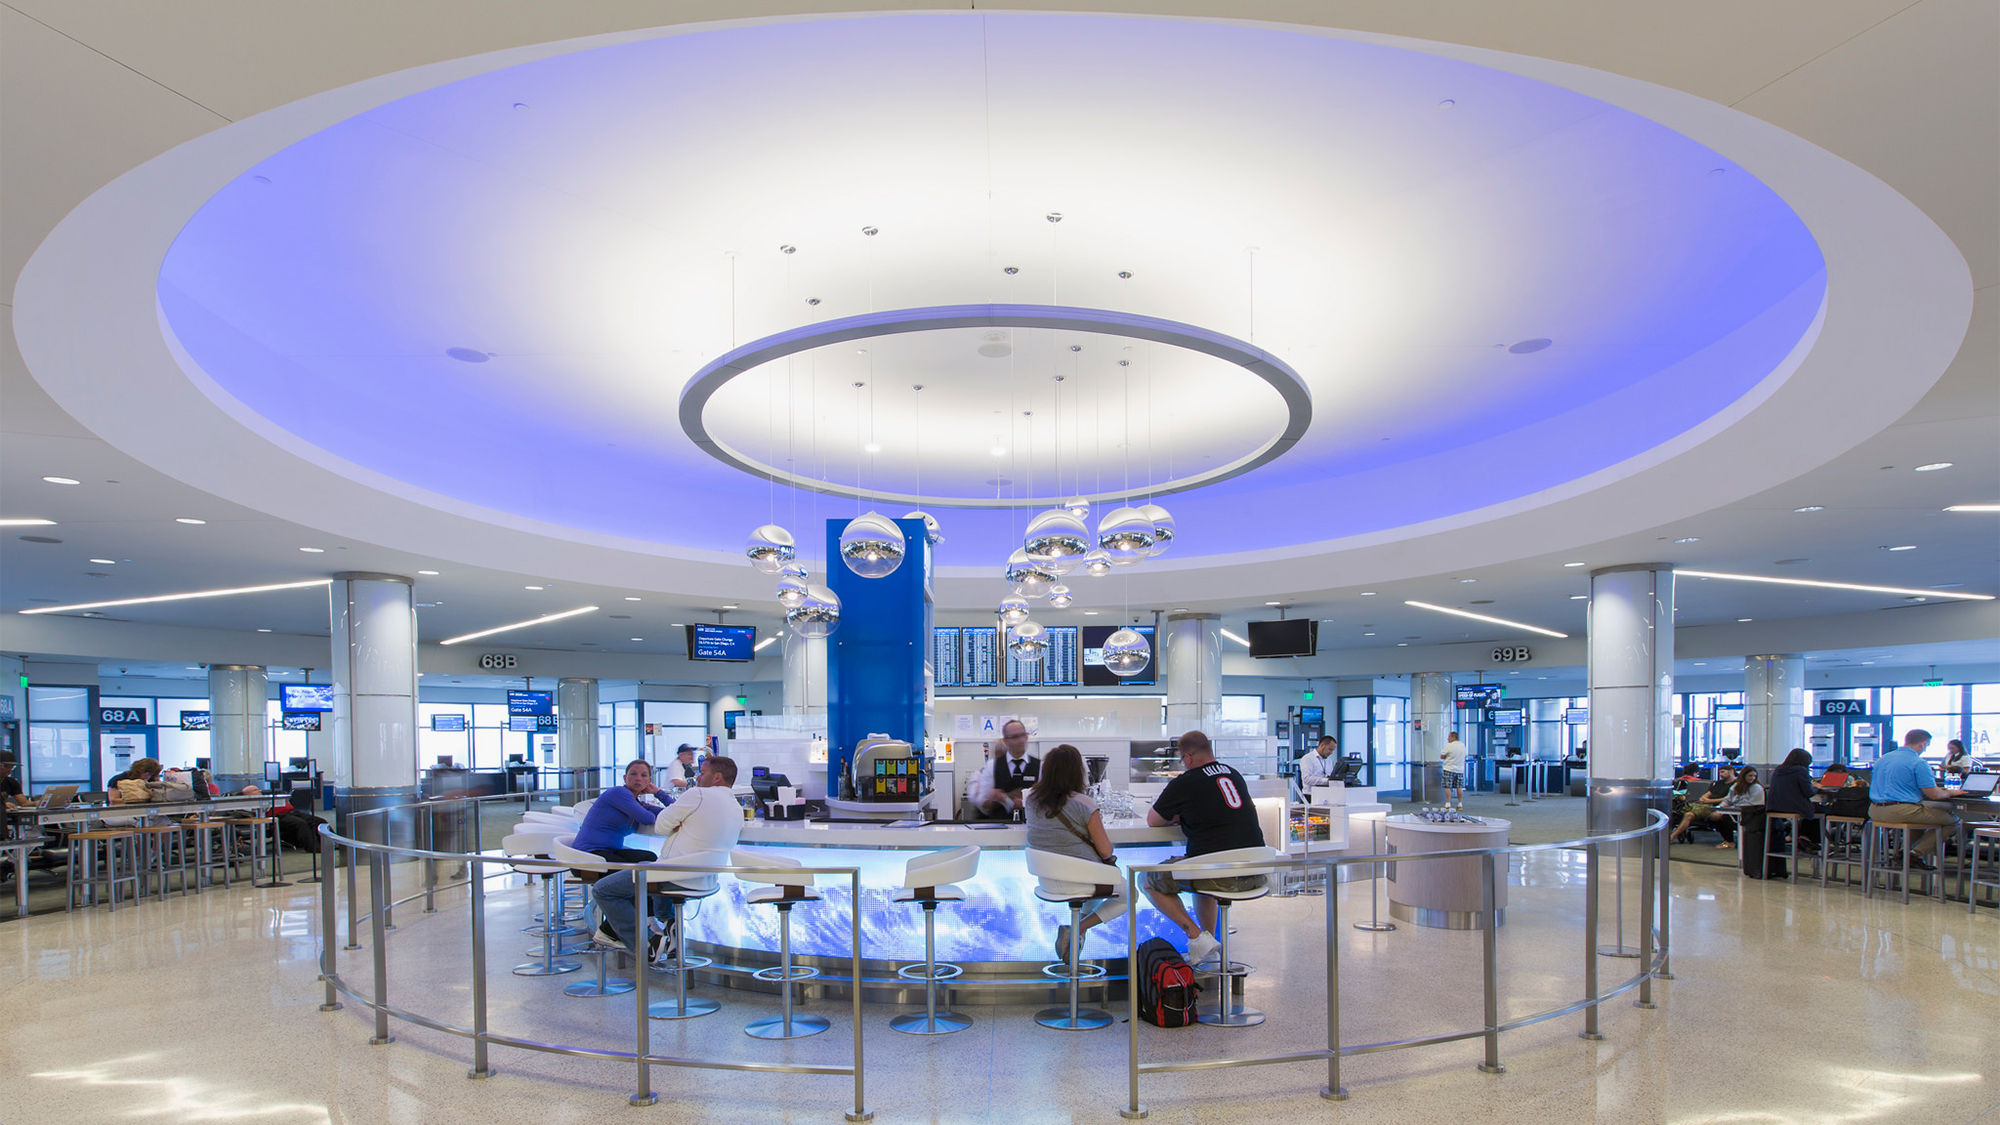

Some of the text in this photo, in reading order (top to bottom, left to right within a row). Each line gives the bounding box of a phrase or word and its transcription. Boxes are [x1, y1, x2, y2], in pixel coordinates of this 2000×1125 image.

[1492, 646, 1530, 662] 69B
[481, 654, 518, 669] 68B
[1825, 701, 1861, 714] 69A
[102, 709, 140, 722] 68A
[984, 719, 994, 731] A
[1216, 776, 1243, 809] 0
